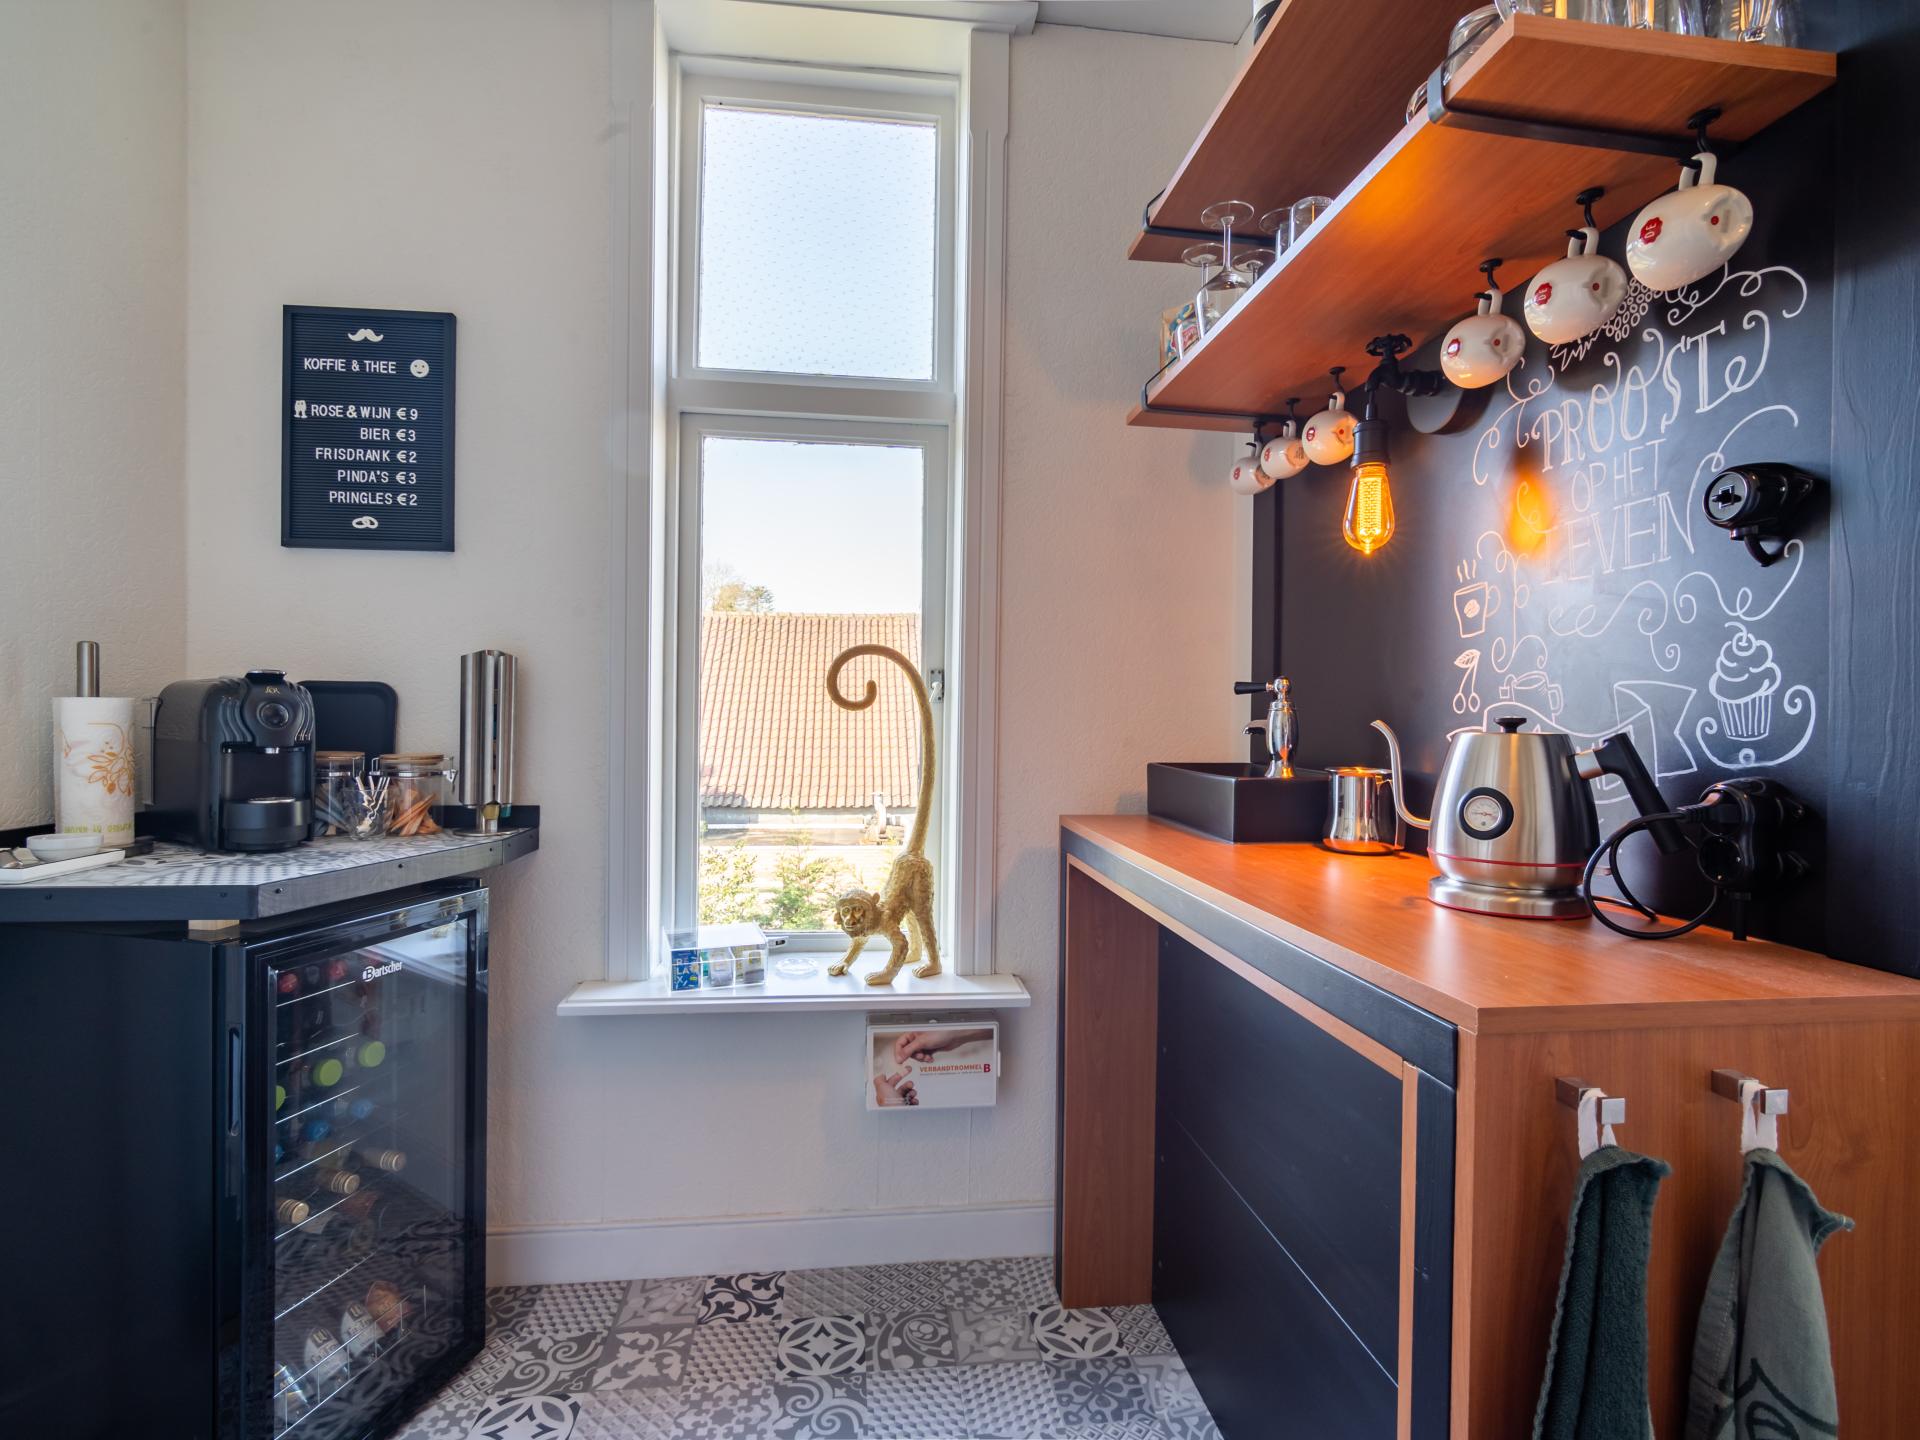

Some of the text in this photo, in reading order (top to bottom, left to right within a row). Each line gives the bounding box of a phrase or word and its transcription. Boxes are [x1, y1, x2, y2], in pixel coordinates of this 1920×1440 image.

[304, 357, 397, 374] KOFFIE & THEE
[1531, 320, 1728, 473] PROOST
[311, 404, 344, 418] ROSE
[346, 404, 358, 419] &
[359, 405, 391, 419] WIJN
[360, 427, 417, 442] BIER €3
[315, 447, 418, 464] FRISDRANK €2
[337, 469, 417, 485] PINDA'S €3
[1612, 438, 1668, 500] HET
[329, 490, 418, 506] PRINGLES €2
[1540, 491, 1695, 586] LEVEN
[362, 960, 403, 982] Bartscher
[919, 1063, 991, 1073] VERBANDTROMMEL B
